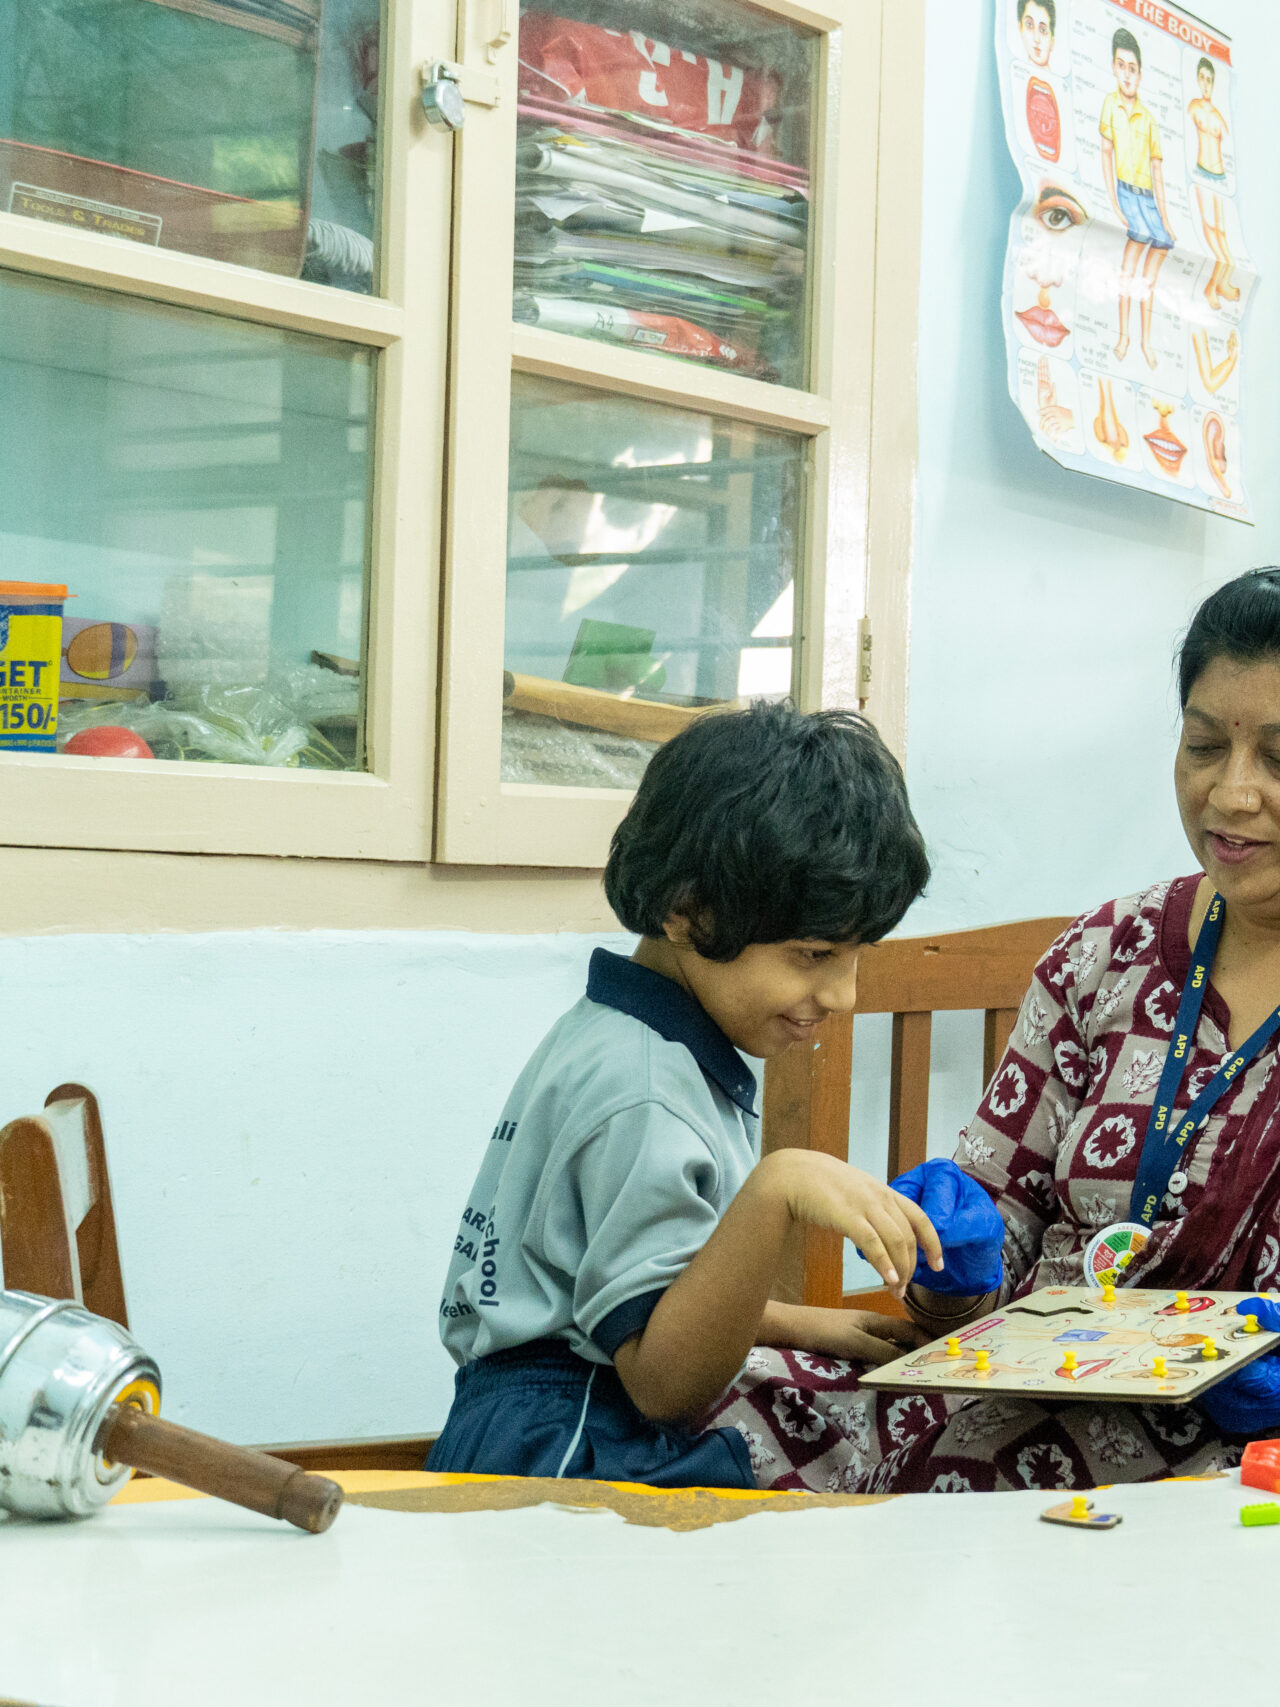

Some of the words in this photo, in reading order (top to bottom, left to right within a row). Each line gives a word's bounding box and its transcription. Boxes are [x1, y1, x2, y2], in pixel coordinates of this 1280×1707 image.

[1135, 0, 1165, 27] THE
[1168, 16, 1213, 53] BODY
[72, 209, 85, 222] &
[595, 311, 614, 330] A4
[1208, 900, 1221, 922] APD
[1191, 964, 1206, 989] APD
[1174, 1033, 1188, 1059] APD
[1223, 1056, 1245, 1081] APD
[1154, 1105, 1168, 1131] APD
[1175, 1120, 1195, 1147] APD
[1140, 1194, 1157, 1223] APD
